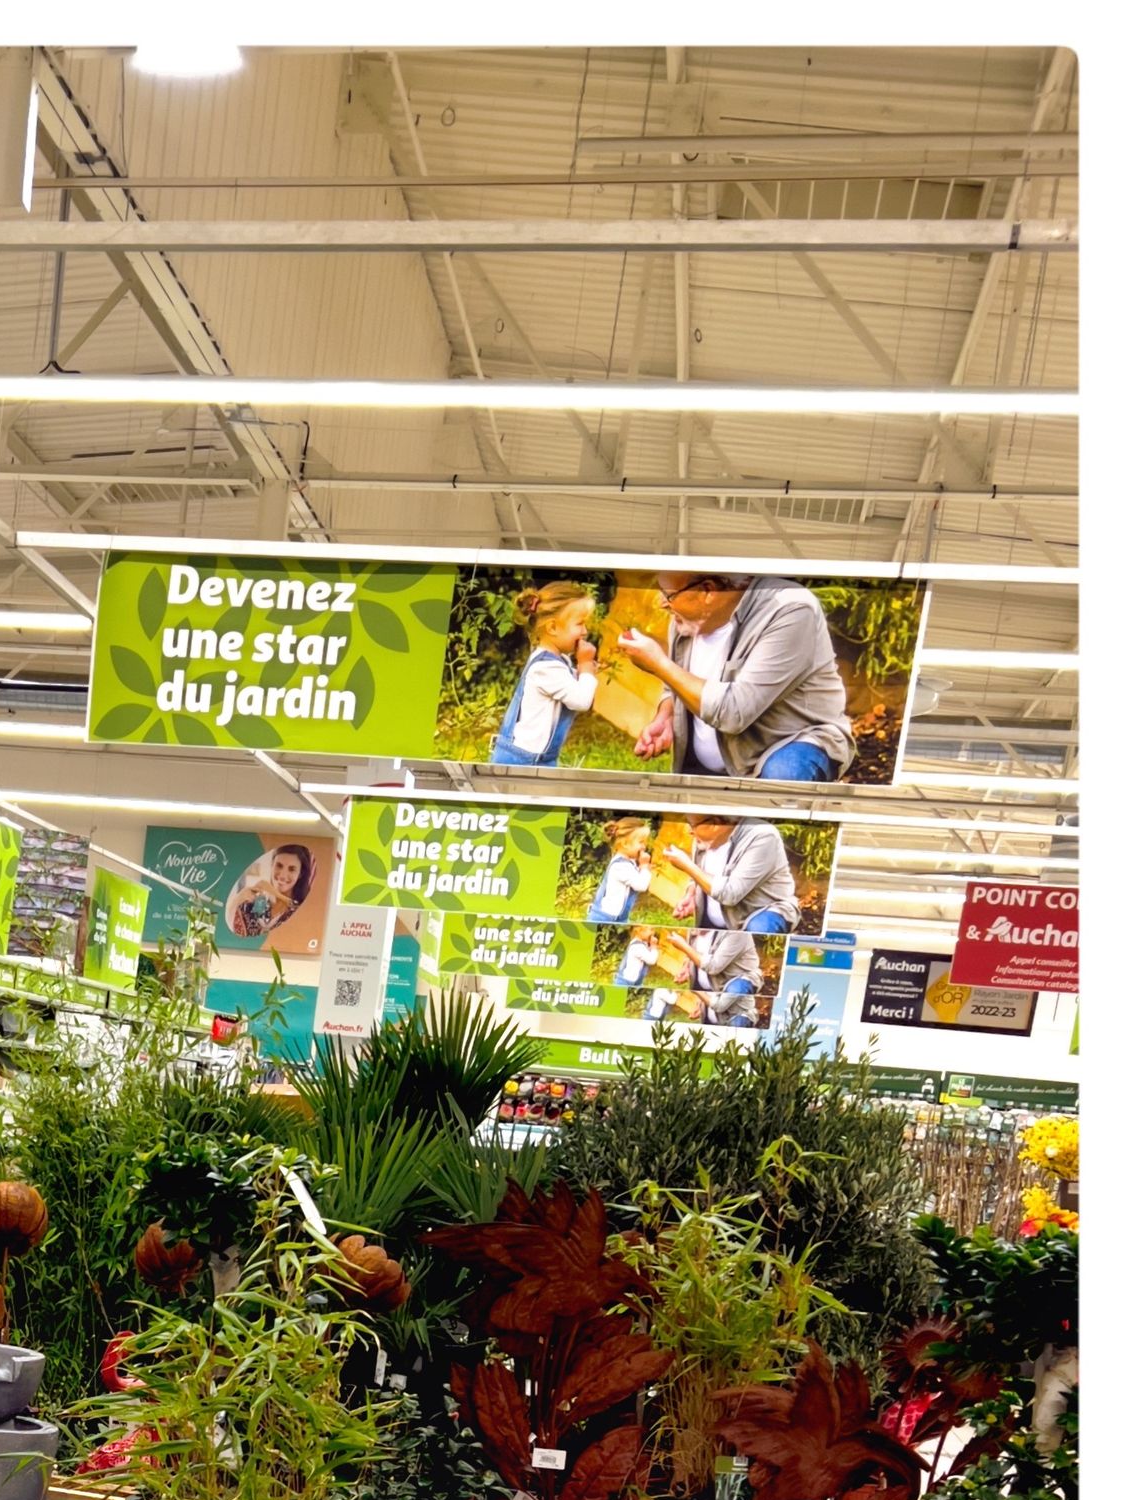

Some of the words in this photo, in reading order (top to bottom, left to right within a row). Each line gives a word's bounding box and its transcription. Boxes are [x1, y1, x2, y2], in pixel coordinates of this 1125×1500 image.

[168, 563, 357, 612] Devenez
[161, 627, 242, 660] une
[253, 625, 347, 666] star
[156, 669, 212, 713] du
[216, 670, 357, 727] jardin
[394, 802, 509, 834] Devenez
[164, 849, 217, 868] Nouvelle
[391, 840, 442, 860] une
[446, 838, 503, 864] star
[179, 866, 207, 884] Vie
[387, 866, 421, 890] du
[423, 866, 509, 898] jardin
[972, 886, 1042, 908] POINT
[1045, 891, 1079, 910] CO
[340, 929, 372, 938] AUCHAN
[473, 927, 509, 942] une
[513, 927, 555, 945] star
[966, 925, 981, 941] &
[984, 916, 1079, 948] Aucha
[470, 943, 496, 963] du
[497, 944, 559, 968] jardin
[874, 956, 925, 973] Auchan
[1009, 955, 1036, 966] Appel
[995, 965, 1051, 977] Informations
[991, 975, 1045, 987] Consultation
[531, 987, 551, 1002] du
[552, 989, 599, 1007] jardin
[870, 1004, 906, 1019] Merci
[909, 1007, 914, 1020] !
[971, 1004, 1016, 1018] 2022-23
[323, 1021, 363, 1033] Auchan.fr
